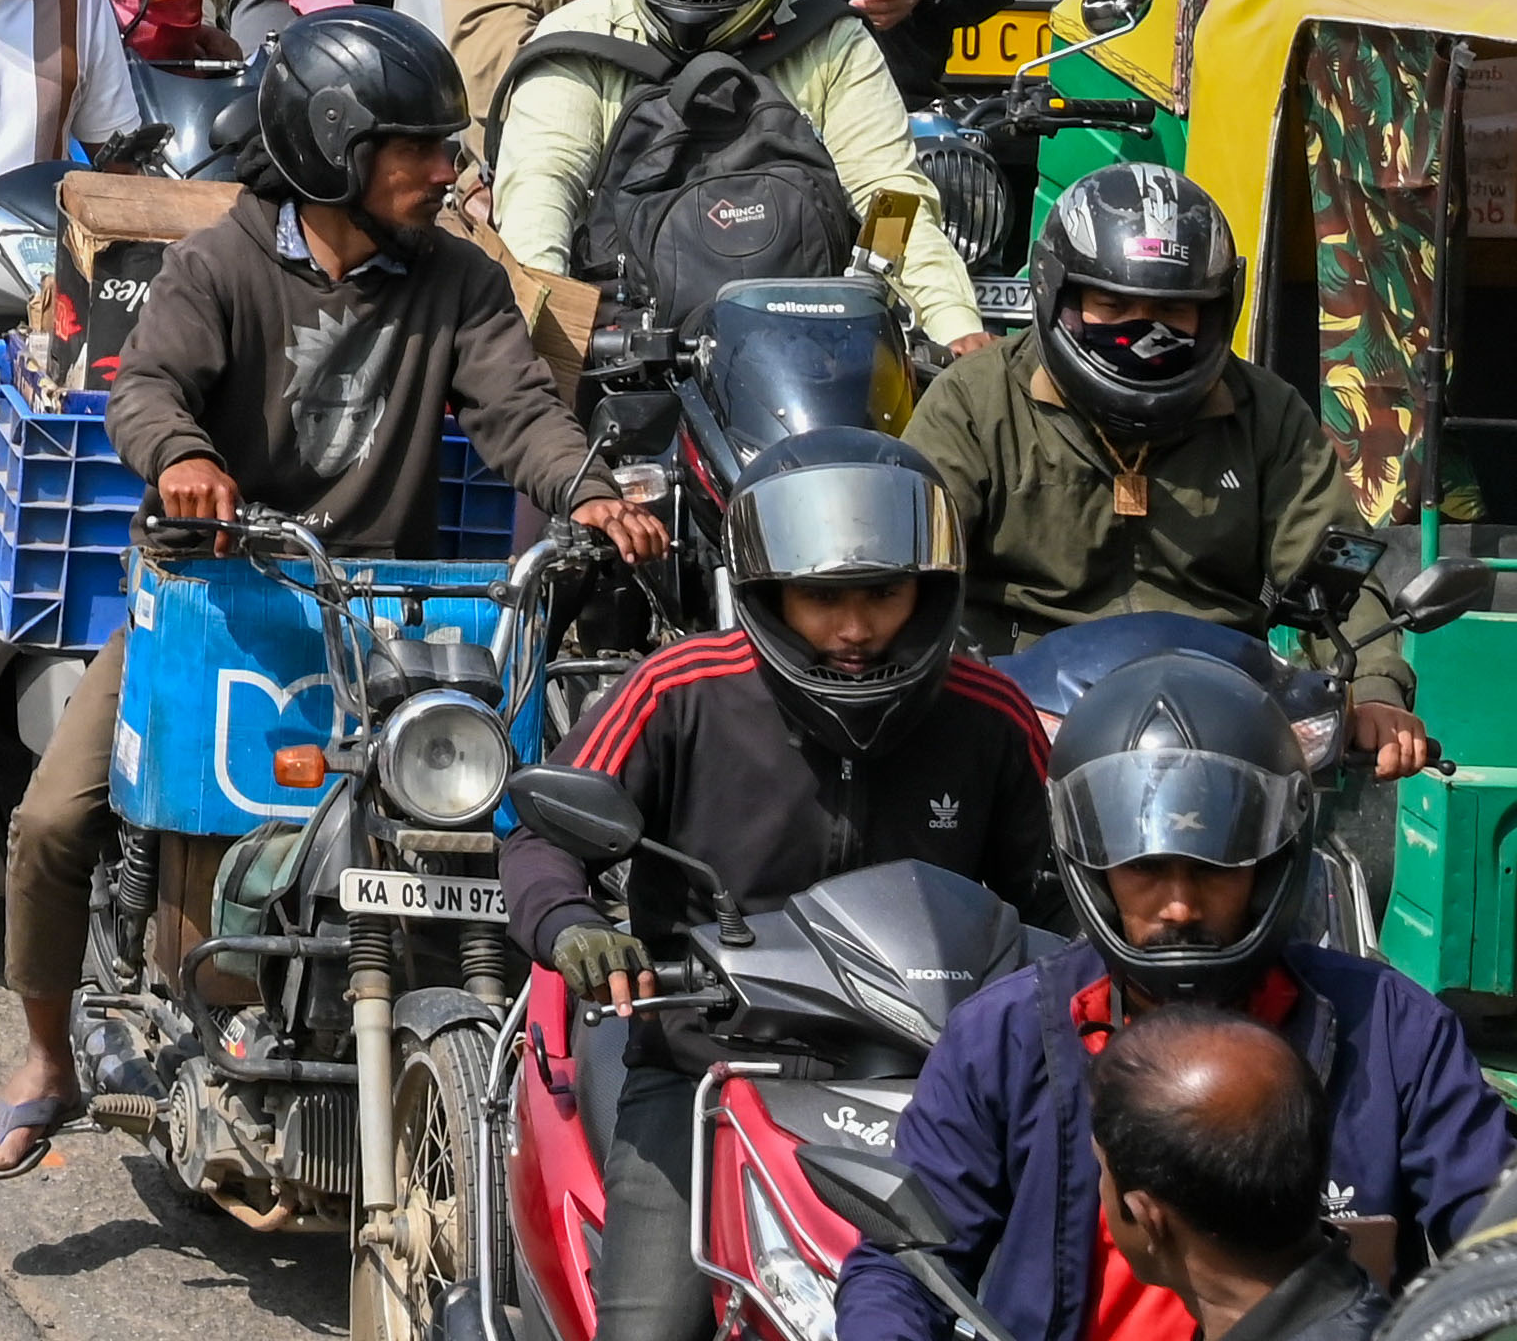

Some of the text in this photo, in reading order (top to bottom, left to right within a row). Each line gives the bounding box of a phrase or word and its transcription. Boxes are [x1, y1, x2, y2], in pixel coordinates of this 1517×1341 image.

[719, 203, 766, 221] BRINCO
[766, 301, 846, 314] celloware
[357, 878, 506, 916] KA 03 JN 973
[905, 969, 974, 981] HONDA
[822, 1105, 890, 1147] Smile
